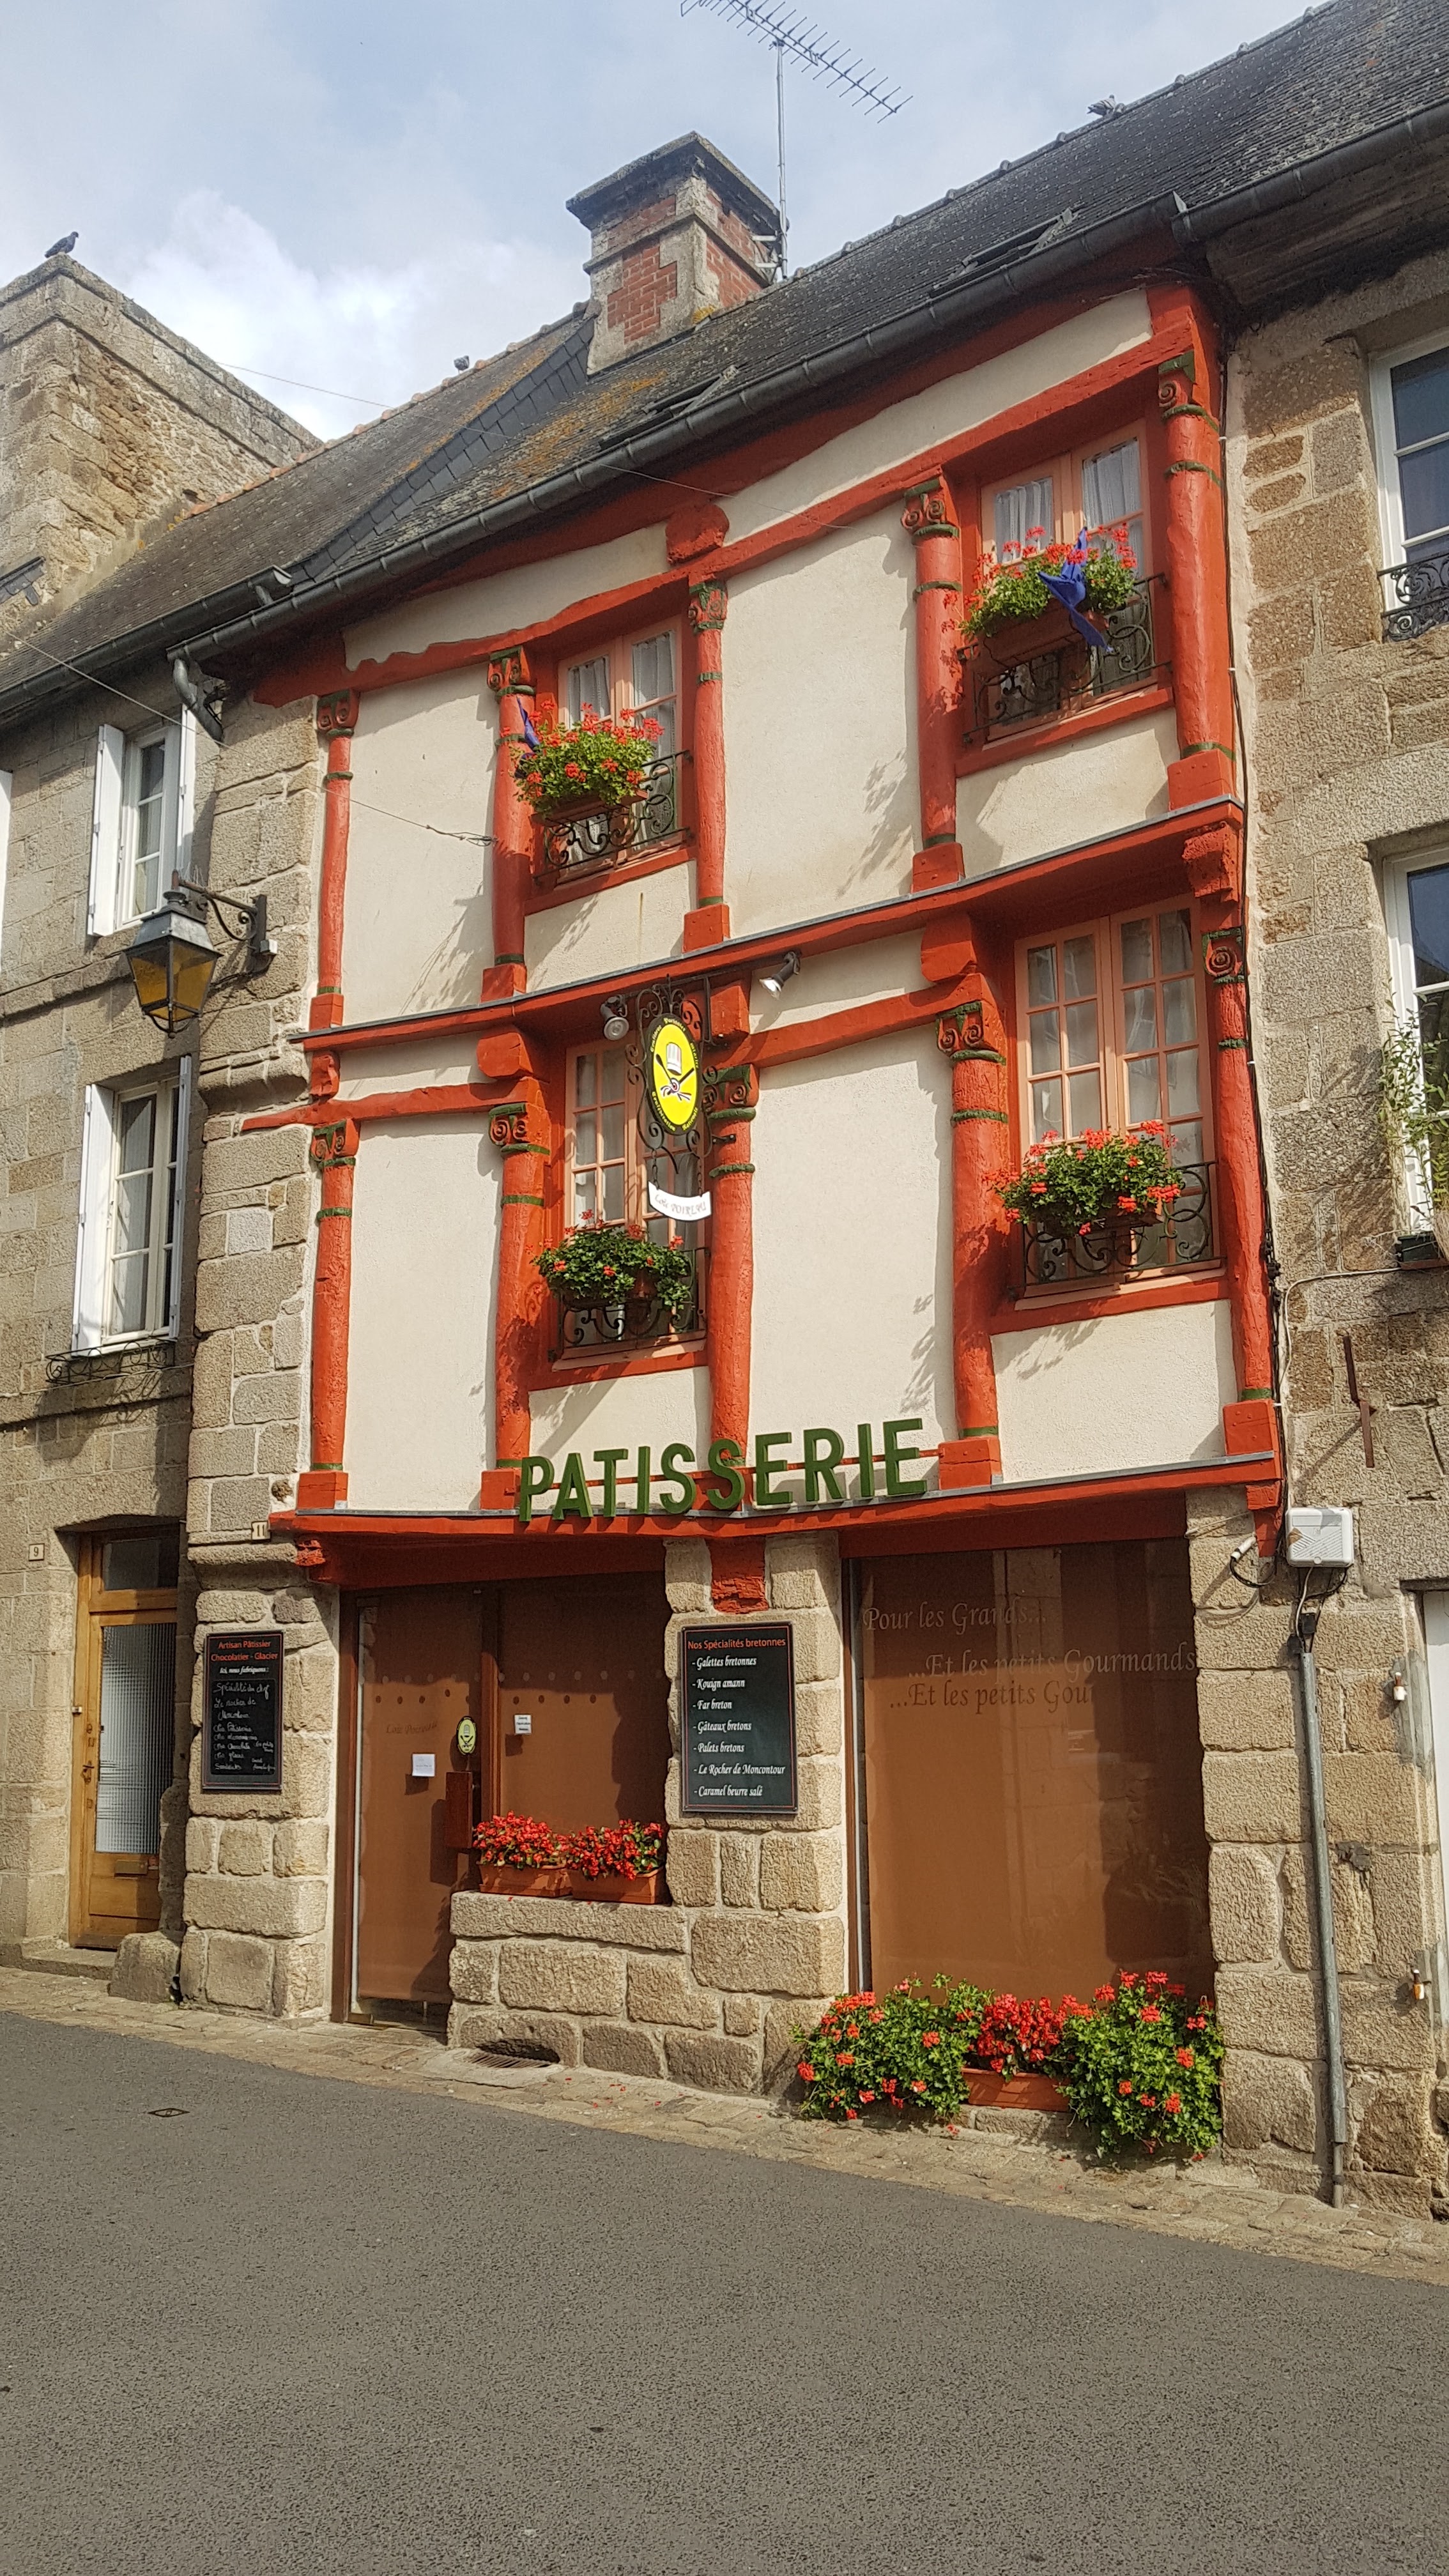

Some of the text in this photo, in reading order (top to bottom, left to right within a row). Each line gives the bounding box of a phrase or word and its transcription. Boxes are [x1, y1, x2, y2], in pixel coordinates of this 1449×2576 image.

[519, 1418, 928, 1522] PATISSERIE
[33, 1546, 39, 1557] 9
[863, 1607, 913, 1630] Pour
[919, 1601, 944, 1629] les
[243, 1639, 272, 1648] Pâtissier
[688, 1638, 786, 1650] Nos Spécialités bretonnes
[211, 1653, 249, 1662] Chocolatier
[254, 1652, 278, 1660] Glacier
[696, 1655, 724, 1671] Galettes
[724, 1655, 757, 1666] bretonnes
[962, 1649, 988, 1676] les
[993, 1649, 1055, 1684] petits
[1064, 1641, 1196, 1683] Gourmands
[696, 1678, 721, 1692] Kouign
[723, 1680, 746, 1688] amann
[697, 1699, 710, 1710] Far
[711, 1698, 732, 1710] breton
[944, 1680, 969, 1706] les
[975, 1680, 1036, 1715] petits
[698, 1721, 727, 1734] Gâteaux
[727, 1719, 752, 1731] bretons
[698, 1741, 719, 1752] Palets
[720, 1741, 745, 1752] bretons
[698, 1764, 707, 1774] Le
[709, 1763, 732, 1776] Rocher
[733, 1763, 741, 1774] de
[742, 1764, 786, 1774] Moncontour
[698, 1784, 726, 1797] Caramel
[727, 1784, 747, 1796] beurre
[749, 1784, 763, 1797] salé
